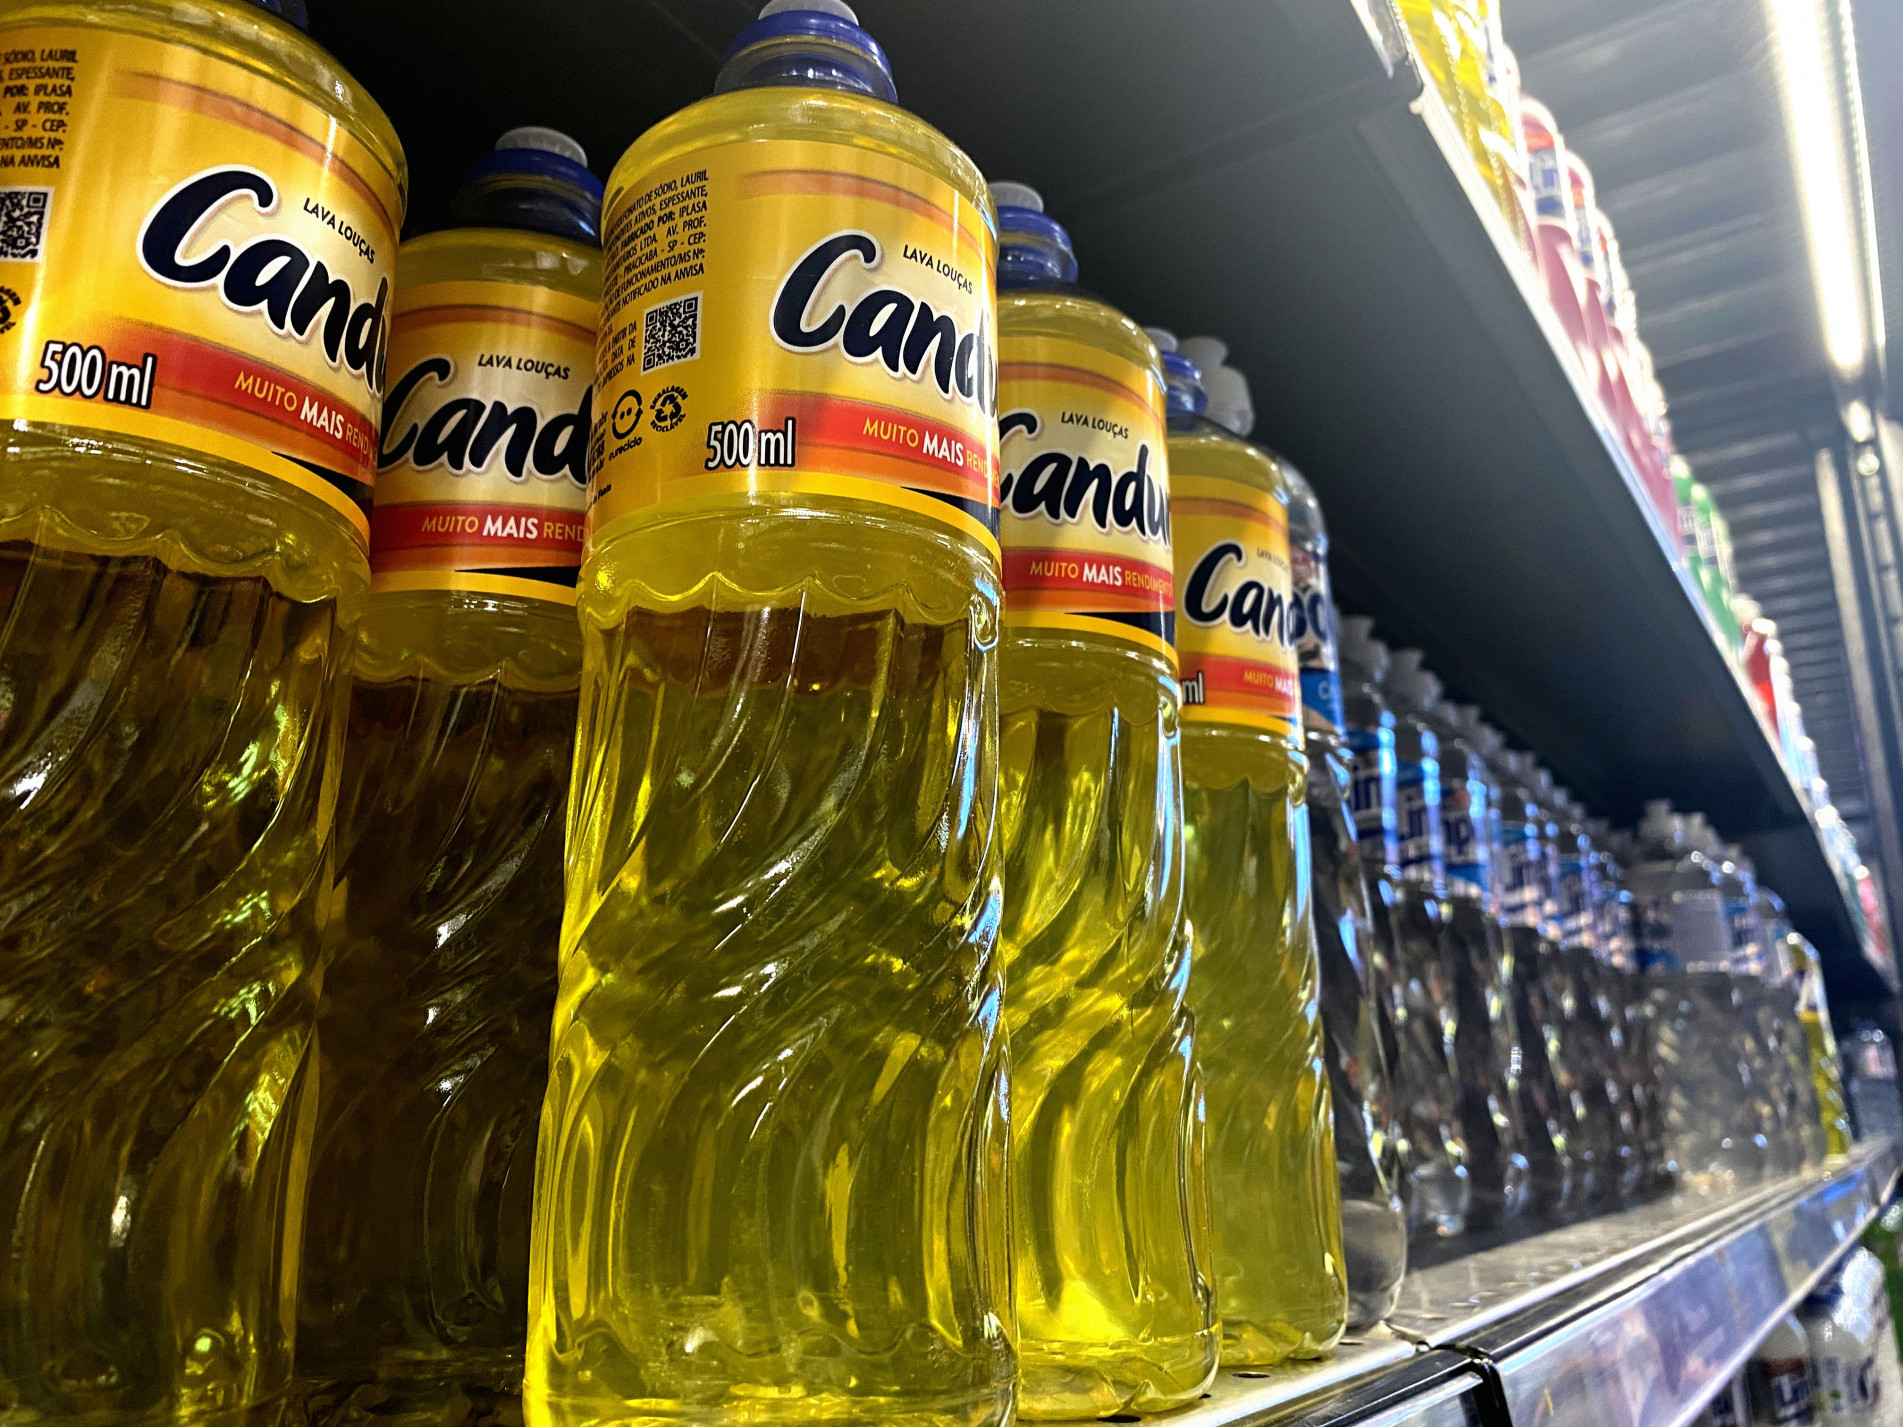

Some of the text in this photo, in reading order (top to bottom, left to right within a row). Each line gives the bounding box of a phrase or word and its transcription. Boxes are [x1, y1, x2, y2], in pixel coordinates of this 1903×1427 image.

[36, 101, 69, 116] PROF.
[13, 118, 28, 133] SP
[42, 118, 68, 133] CEP:
[18, 154, 60, 169] ANVISA
[680, 169, 709, 187] LAURIL
[659, 185, 708, 212] ESPESSANTE,
[657, 211, 676, 227] POR:
[679, 200, 707, 218] IPLASA
[303, 198, 375, 264] LAVA LOUÇAS
[666, 224, 679, 239] AV.
[682, 216, 706, 233] PROF.
[623, 247, 658, 278] PIRACICABA
[667, 240, 677, 253] SP
[687, 231, 706, 246] CEP:
[902, 244, 973, 295] LAVA LOUÇAS
[621, 277, 658, 309] NOTIFICADO
[660, 272, 672, 287] NA
[673, 262, 704, 281] ANVISA
[628, 320, 637, 336] DA
[477, 353, 571, 381] LAVA LOUÇAS
[626, 352, 636, 368] NA
[37, 341, 157, 409] 500 ml
[234, 370, 297, 411] MUITO
[300, 395, 345, 440] MAIS
[1060, 411, 1129, 440] LAVA LOUÇAS
[705, 417, 796, 470] 500 ml
[862, 416, 919, 448] MUITO
[922, 430, 964, 467] MAIS
[421, 515, 479, 533] MUITO
[482, 514, 539, 540] MAIS
[1029, 560, 1079, 579] MUITO
[1082, 561, 1123, 587] MAIS
[1243, 669, 1274, 688] MUITO
